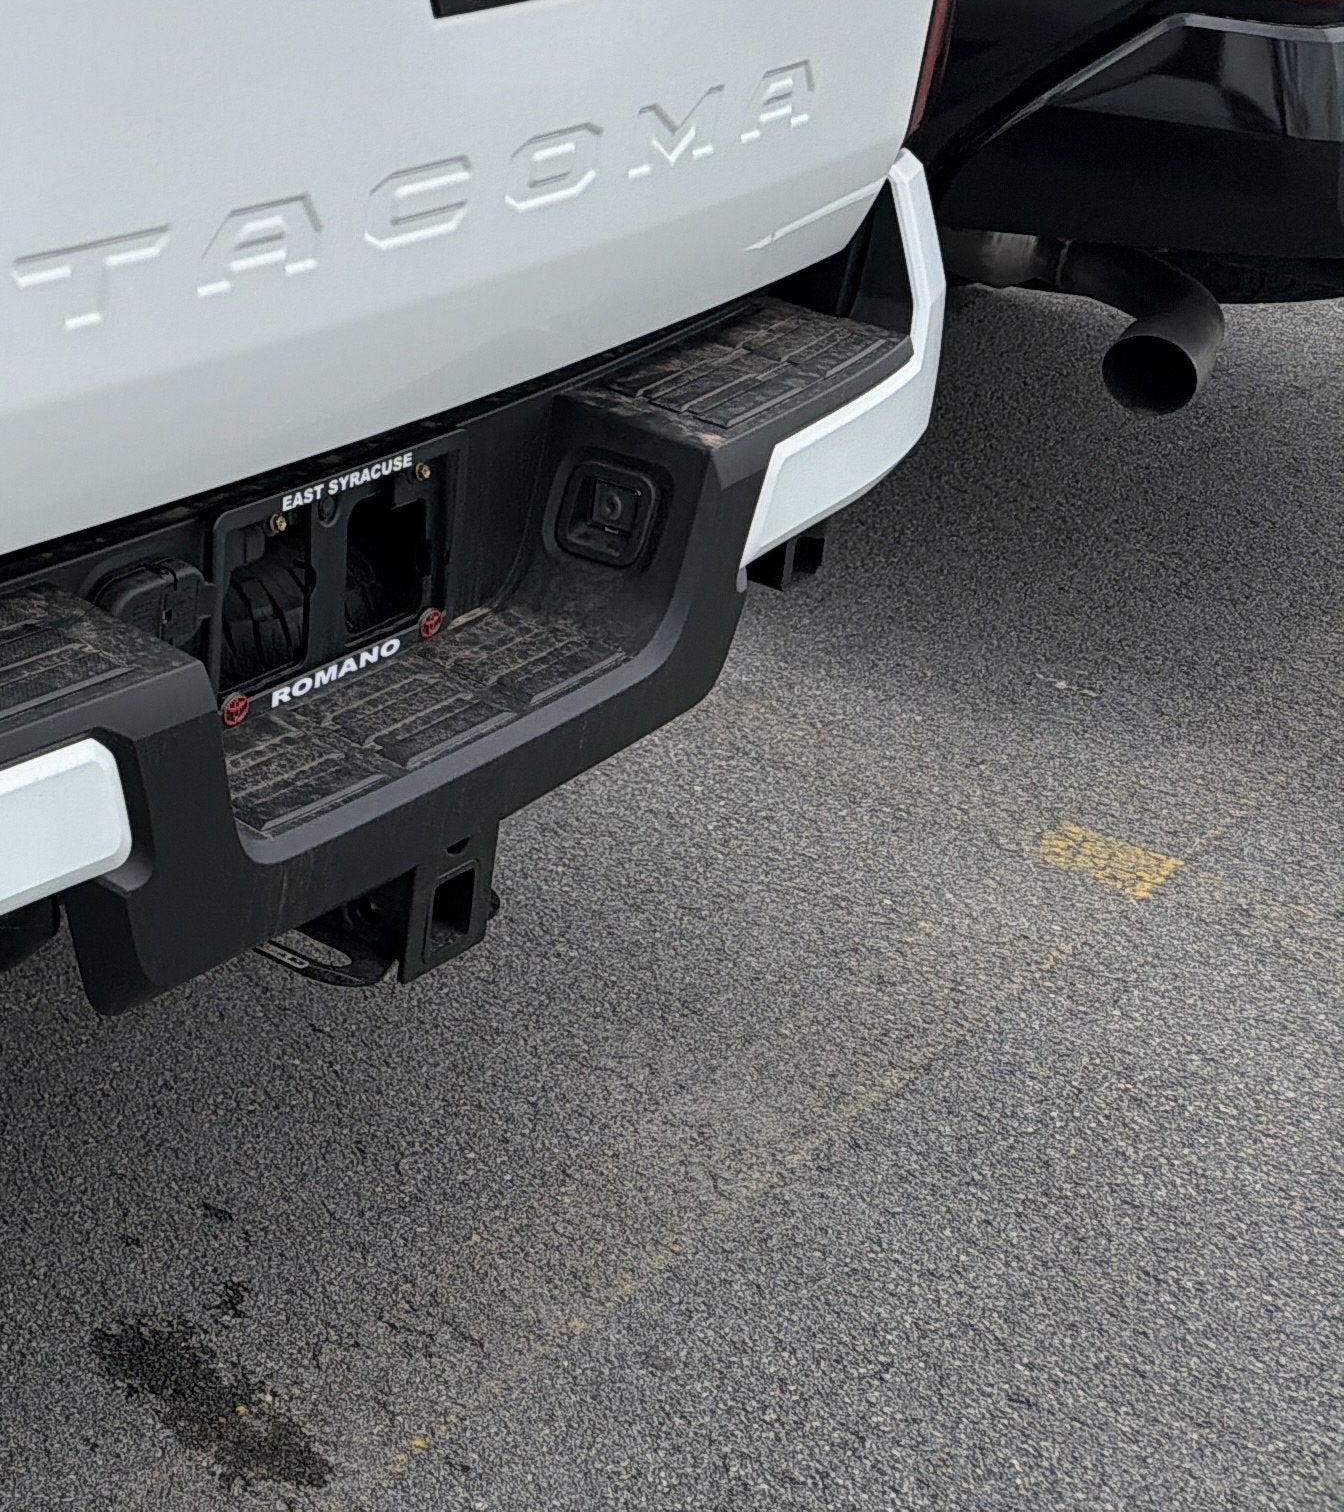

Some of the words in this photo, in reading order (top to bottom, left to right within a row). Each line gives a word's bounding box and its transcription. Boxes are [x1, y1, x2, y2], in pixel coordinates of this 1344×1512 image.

[12, 59, 815, 330] TACOMA
[281, 484, 325, 512] EAST
[327, 451, 413, 496] SYRACUSE
[271, 638, 401, 708] ROMANO
